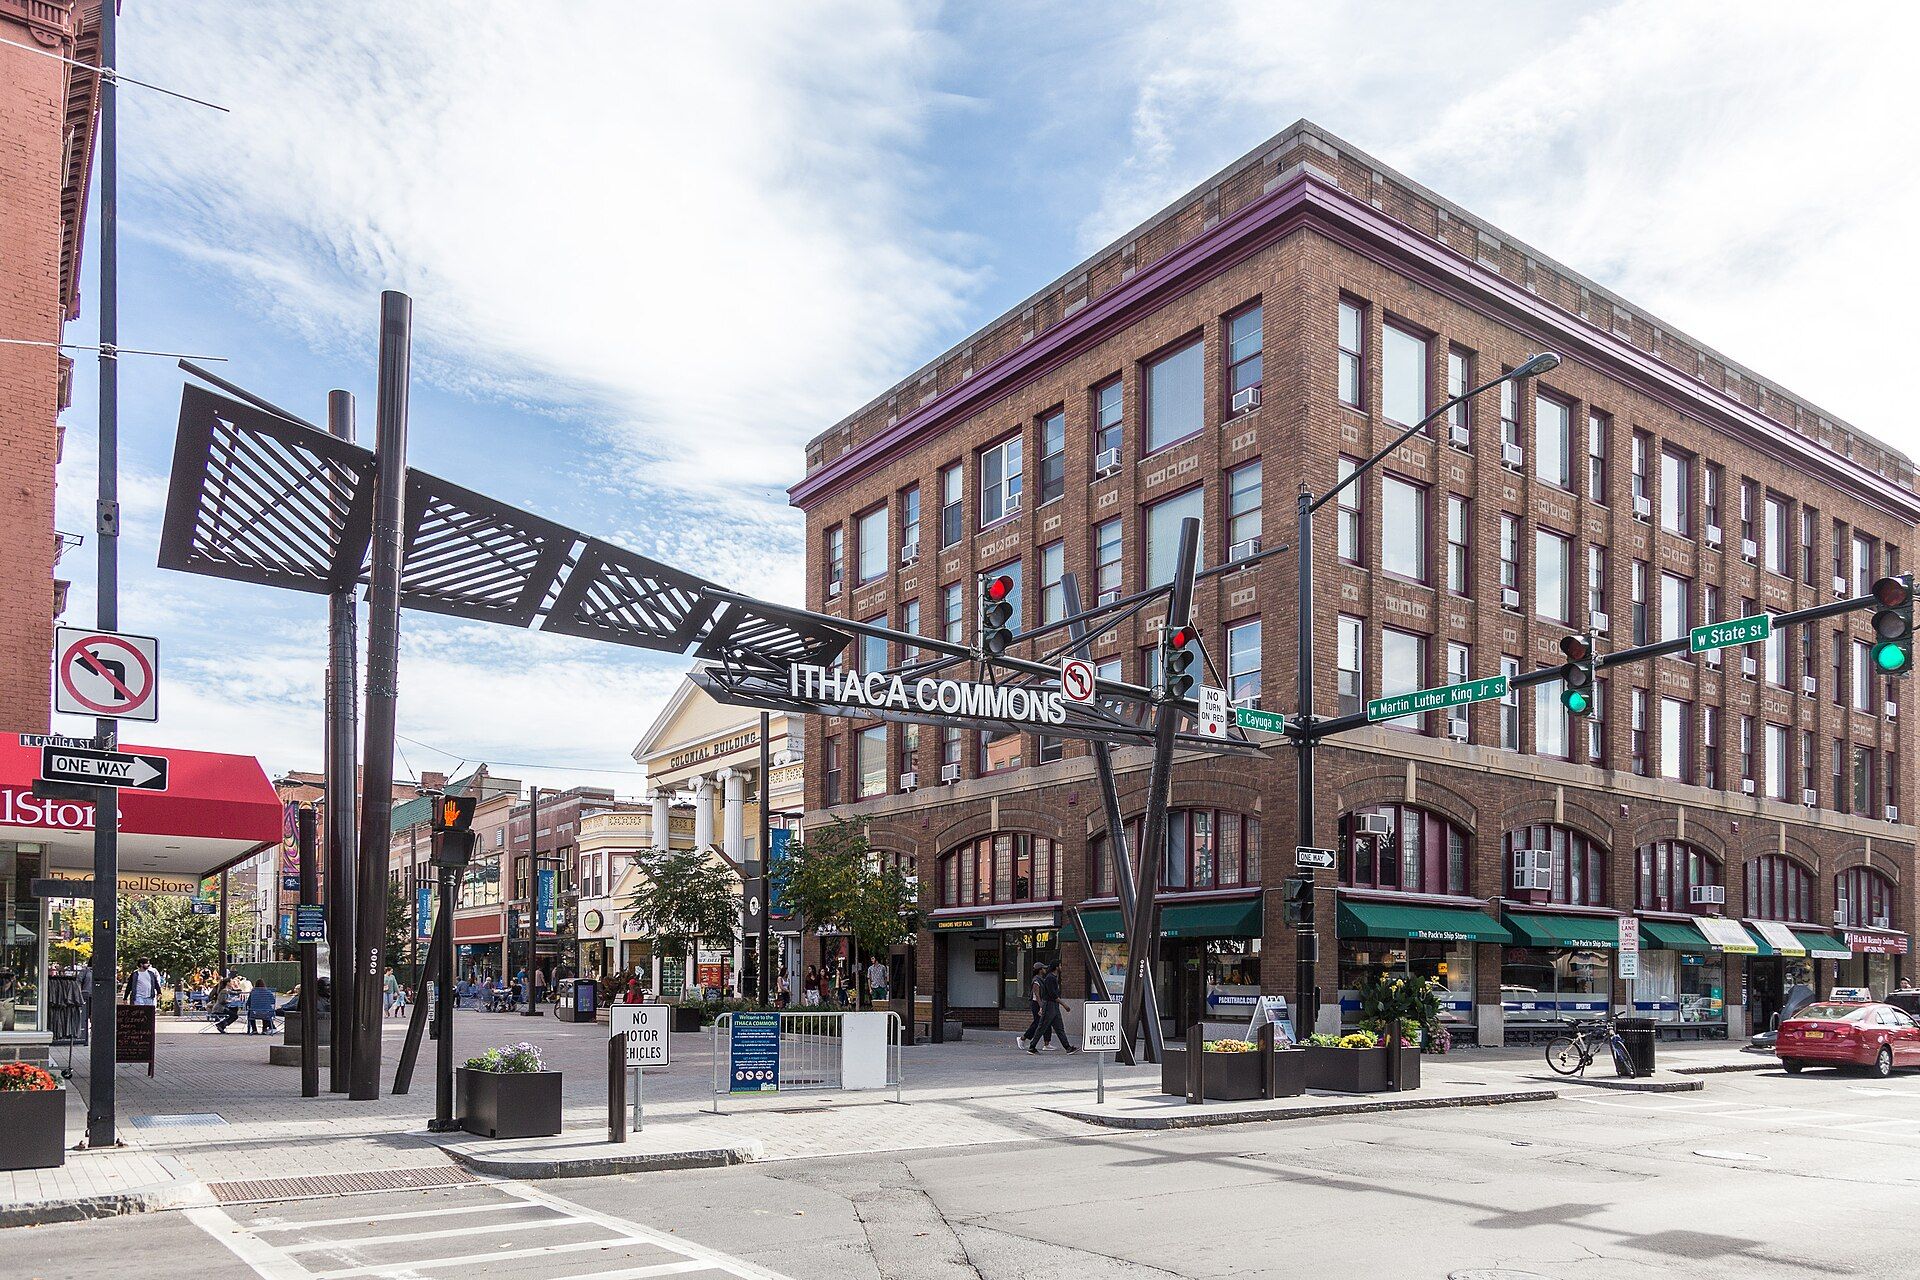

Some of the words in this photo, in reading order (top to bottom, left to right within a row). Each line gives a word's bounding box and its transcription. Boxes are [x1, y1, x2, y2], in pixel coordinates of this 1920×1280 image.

[1698, 634, 1706, 646] W
[1710, 626, 1746, 644] State
[1750, 624, 1762, 636] St
[790, 662, 910, 709] ITHACA
[916, 677, 1067, 724] COMMONS
[1206, 690, 1219, 702] NO
[1370, 706, 1377, 716] W
[1380, 700, 1410, 714] Martin
[1414, 692, 1446, 708] Luther
[1451, 687, 1472, 702] King
[1478, 684, 1489, 697] Jr
[1494, 683, 1504, 694] St
[1204, 702, 1221, 712] TURN
[1202, 711, 1210, 720] ON
[1212, 713, 1225, 723] RED
[1238, 713, 1243, 723] S
[1246, 714, 1272, 731] Cayuga
[1276, 720, 1282, 730] St
[36, 736, 74, 748] CAYUGA
[670, 747, 710, 768] COLONIAL
[714, 732, 756, 755] BUILDING
[56, 757, 91, 773] ONE
[96, 761, 132, 777] WAY
[1300, 853, 1312, 862] ONE
[1313, 854, 1324, 862] WAY
[102, 920, 108, 928] 1
[1418, 930, 1428, 938] The
[1428, 931, 1444, 939] Pack'n
[1444, 932, 1454, 940] Ship
[1454, 932, 1467, 940] Store
[1592, 940, 1601, 948] Ship
[1868, 936, 1882, 946] Beauty
[1882, 936, 1894, 944] Salon
[1218, 996, 1256, 1004] PACKITHACA.COM
[632, 1012, 648, 1024] NO
[1098, 1008, 1108, 1018] NO
[1092, 1022, 1114, 1032] MOTOR
[1089, 1035, 1116, 1046] VEHICLES
